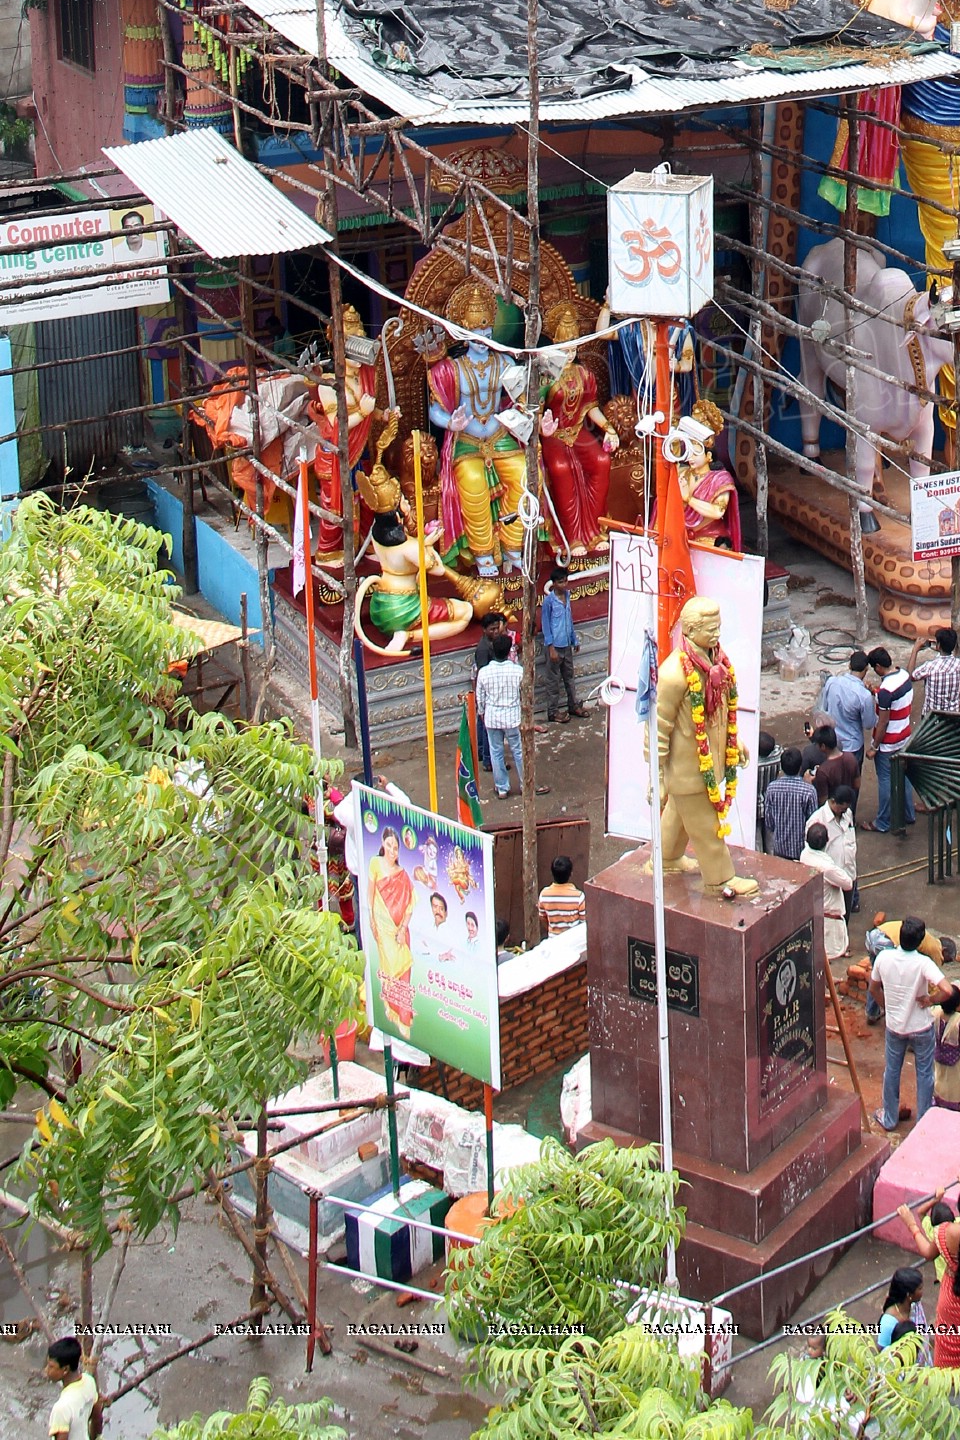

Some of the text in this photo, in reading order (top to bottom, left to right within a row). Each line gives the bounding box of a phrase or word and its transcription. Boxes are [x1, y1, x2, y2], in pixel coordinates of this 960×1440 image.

[7, 217, 102, 245] Computer
[41, 242, 104, 264] Centre
[792, 999, 800, 1012] R
